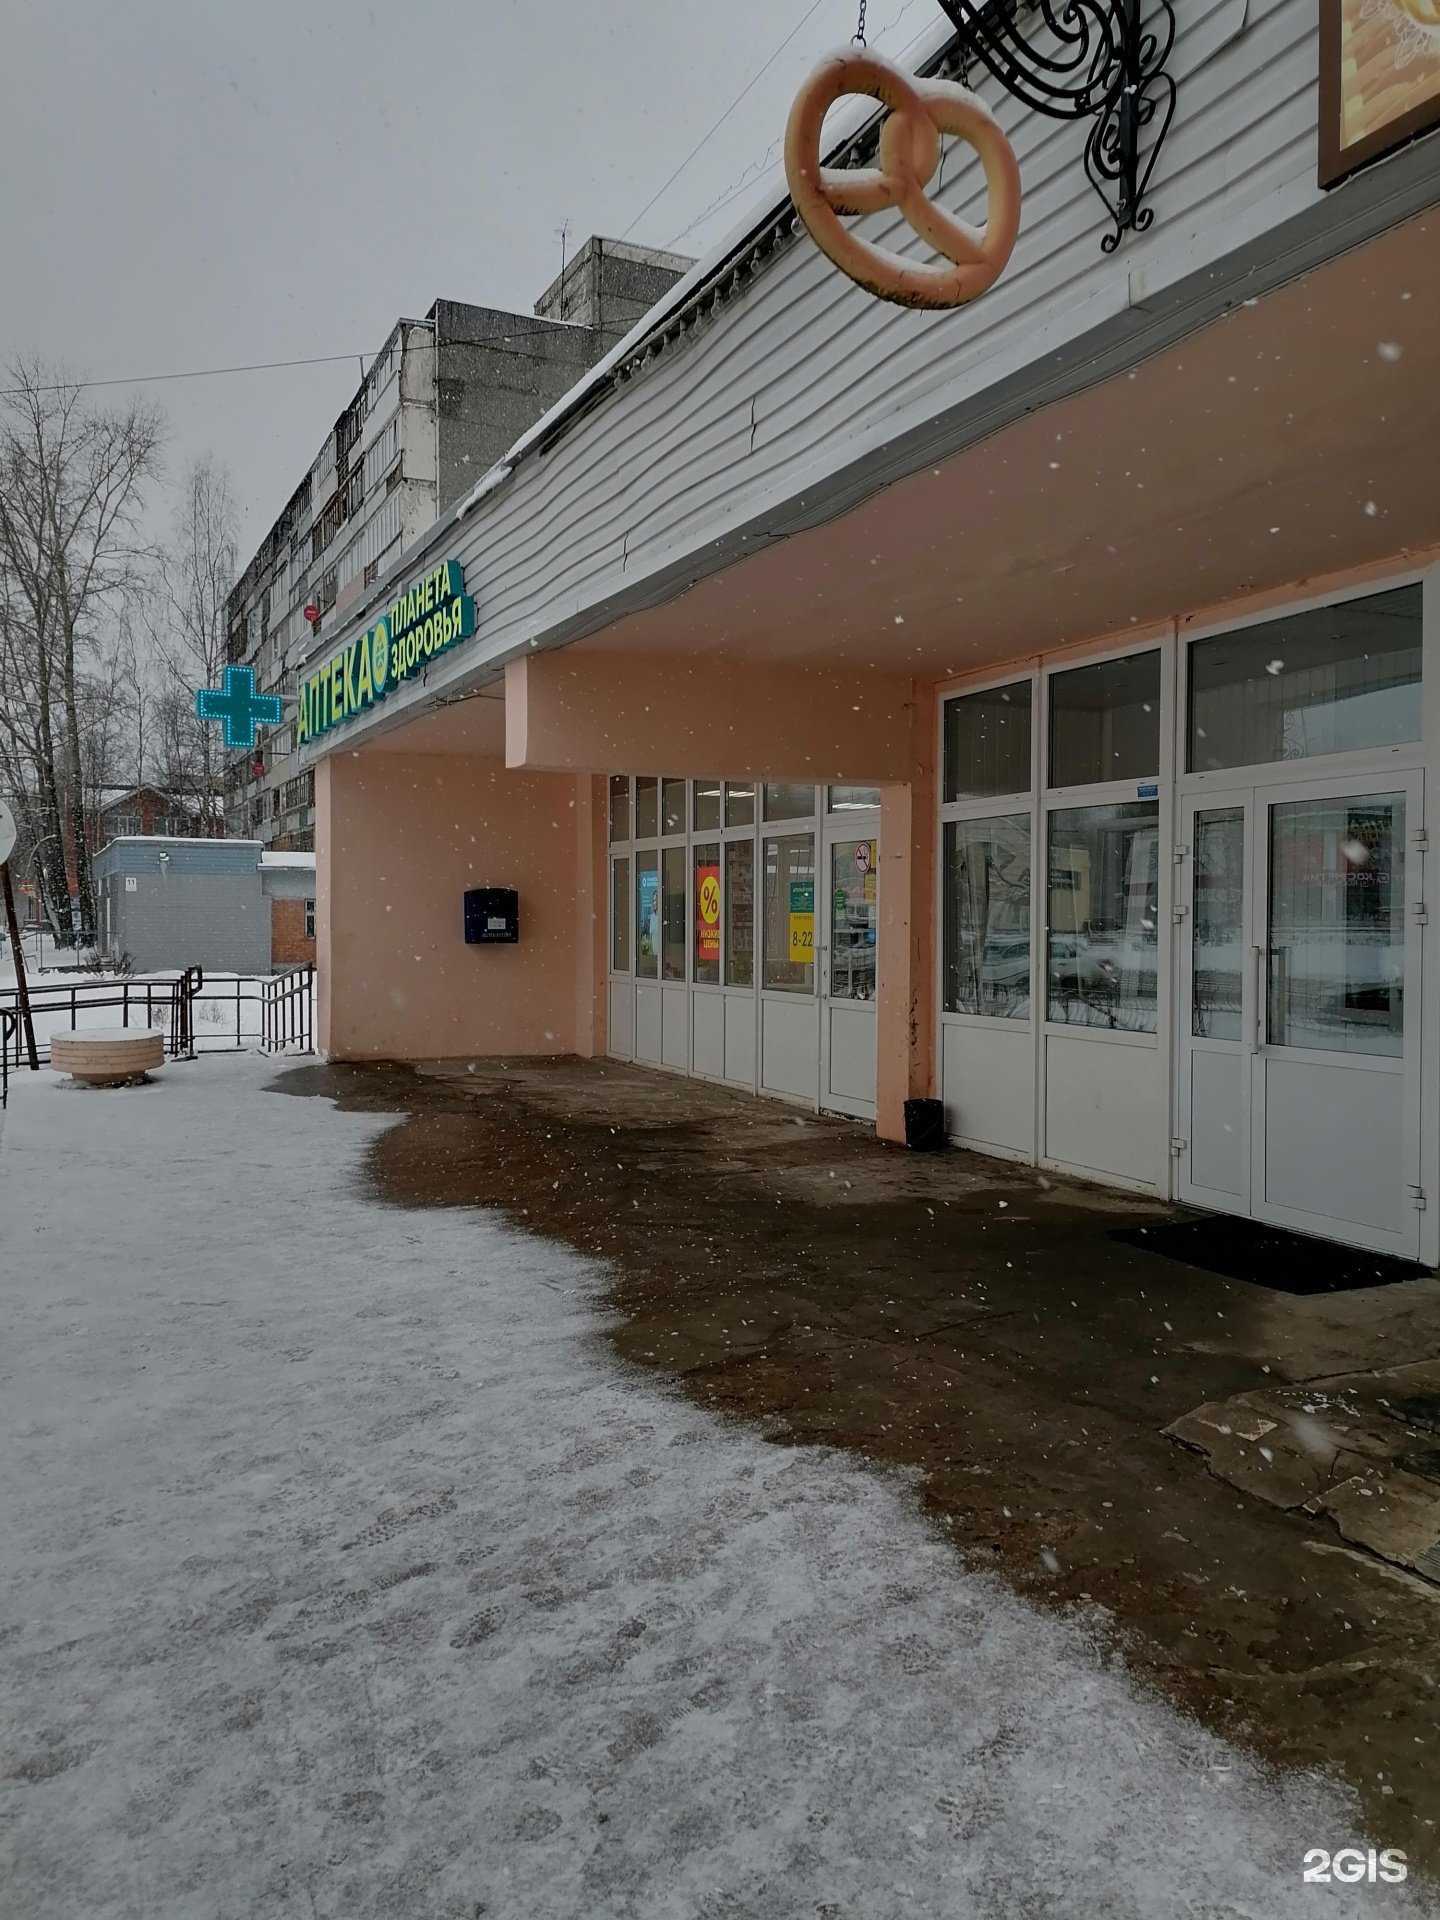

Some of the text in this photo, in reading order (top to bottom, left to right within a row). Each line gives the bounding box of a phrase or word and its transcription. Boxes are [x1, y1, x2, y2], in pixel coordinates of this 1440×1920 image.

[390, 561, 451, 637] ПЛАНЕТА
[391, 596, 462, 680] ЗДОРОВЬЯ
[297, 634, 373, 743] АПТЕКА
